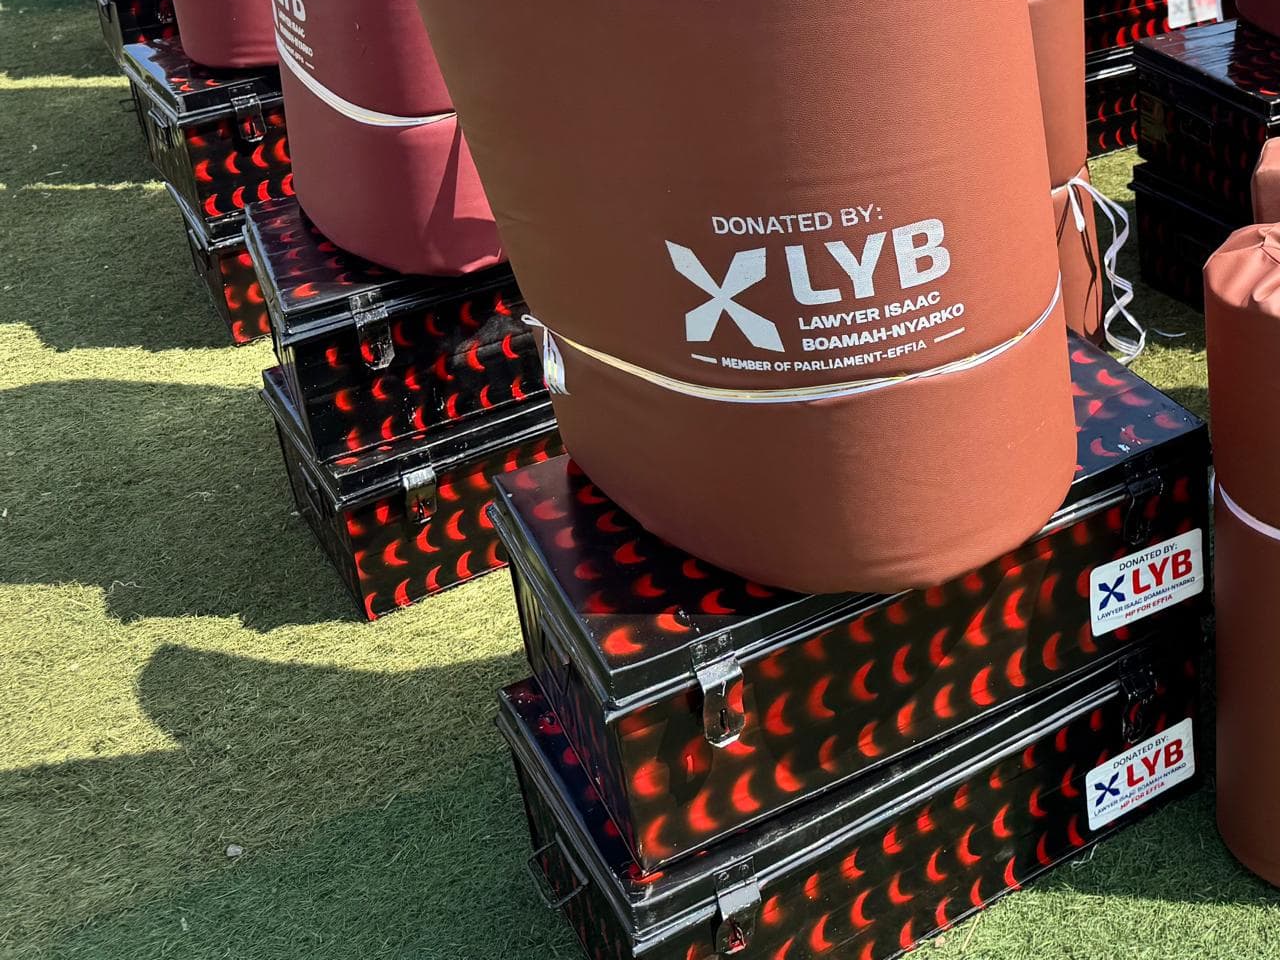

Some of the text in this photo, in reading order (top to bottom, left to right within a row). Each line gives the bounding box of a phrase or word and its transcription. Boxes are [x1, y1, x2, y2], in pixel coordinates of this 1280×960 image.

[712, 203, 883, 235] DONATED BY:
[784, 218, 951, 306] LYB
[798, 291, 940, 330] LAWYER ISAAC
[802, 303, 965, 352] BOAMAH-NYARKO
[721, 340, 927, 372] MEMBER OF PARLIAMENT-EFFIA
[1119, 542, 1178, 571] DONATED BY:
[1132, 549, 1193, 595] LYB
[1097, 576, 1195, 621] LAWYER ISAAC BOAMAH-NYARKO
[1125, 594, 1173, 618] MP FOR EFFIA
[1113, 735, 1168, 769] DONATED BY:
[1126, 738, 1184, 788] LYB
[1094, 800, 1118, 817] LAWYER
[1120, 782, 1165, 810] MP FOR EFFIA
